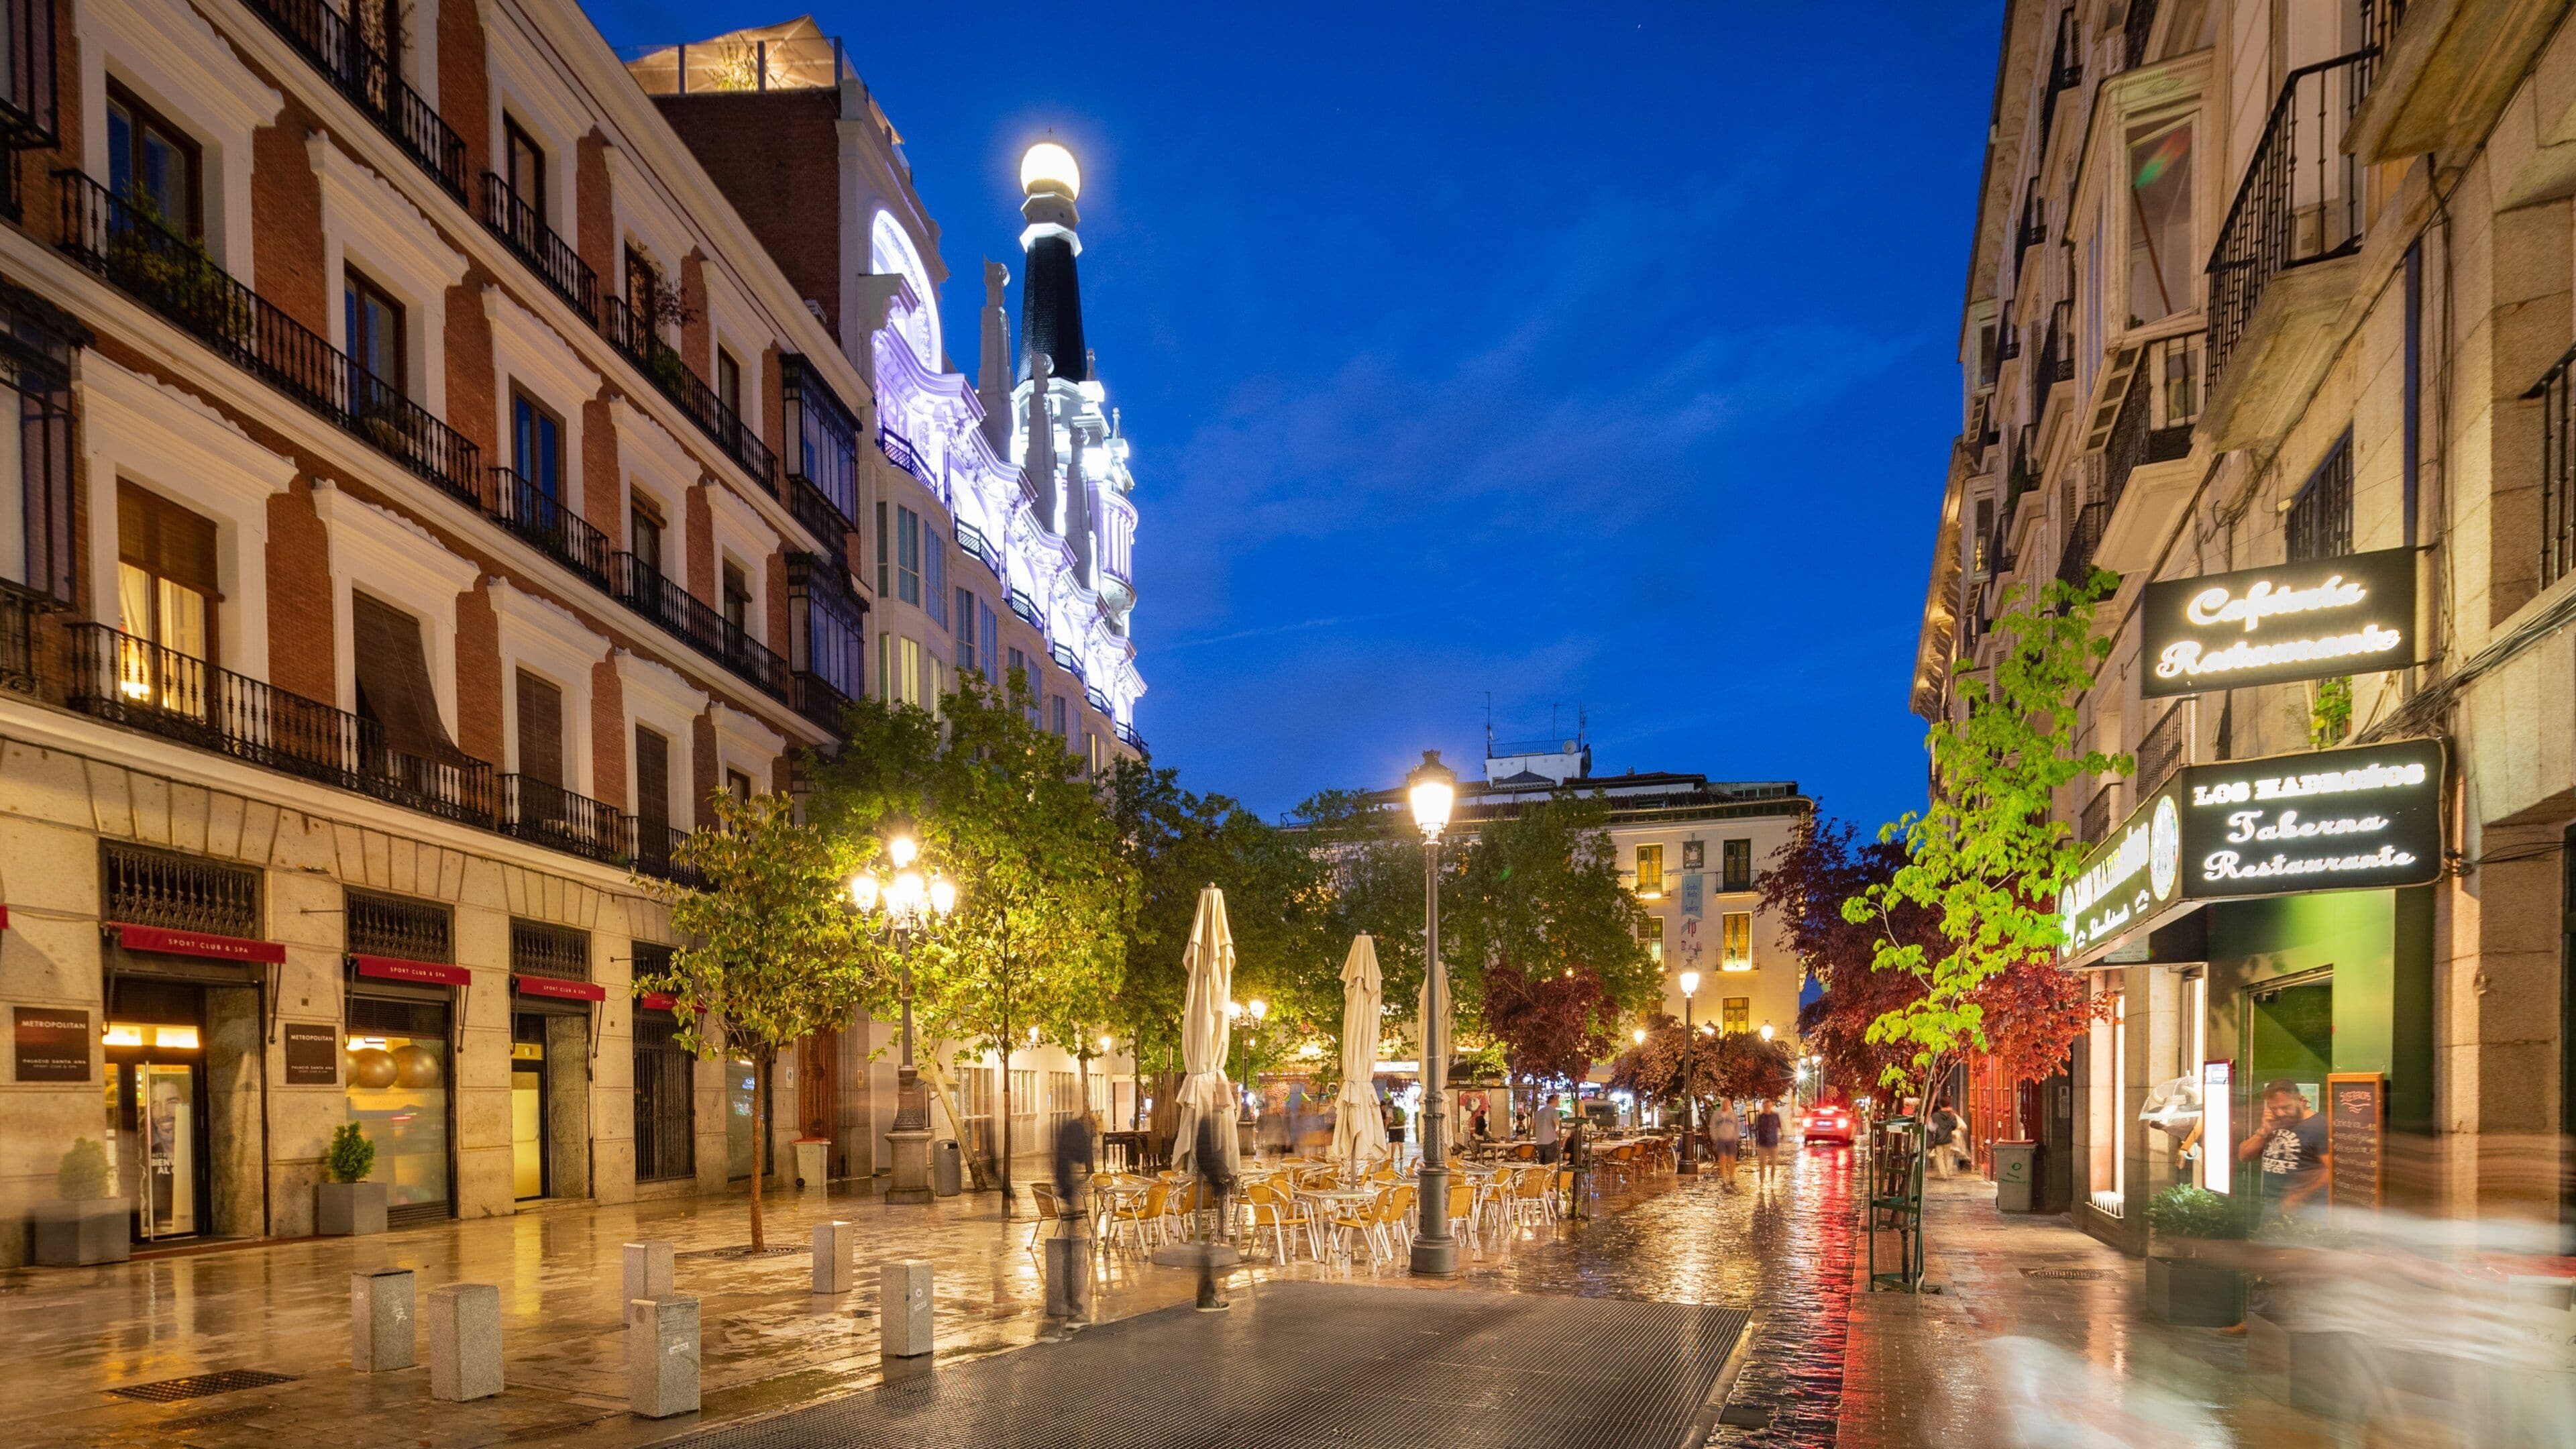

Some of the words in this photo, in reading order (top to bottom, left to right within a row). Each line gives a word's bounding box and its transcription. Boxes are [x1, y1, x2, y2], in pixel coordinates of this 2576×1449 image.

[2194, 782, 2250, 806] LOS
[2227, 810, 2389, 843] Taberna
[2204, 845, 2416, 881] Restaurante
[168, 938, 195, 947] SPORT
[199, 942, 221, 951] CLUB
[234, 946, 249, 954] SPA
[21, 1020, 87, 1029] METROPOLITAN
[290, 1034, 334, 1042] METROPOLITAN
